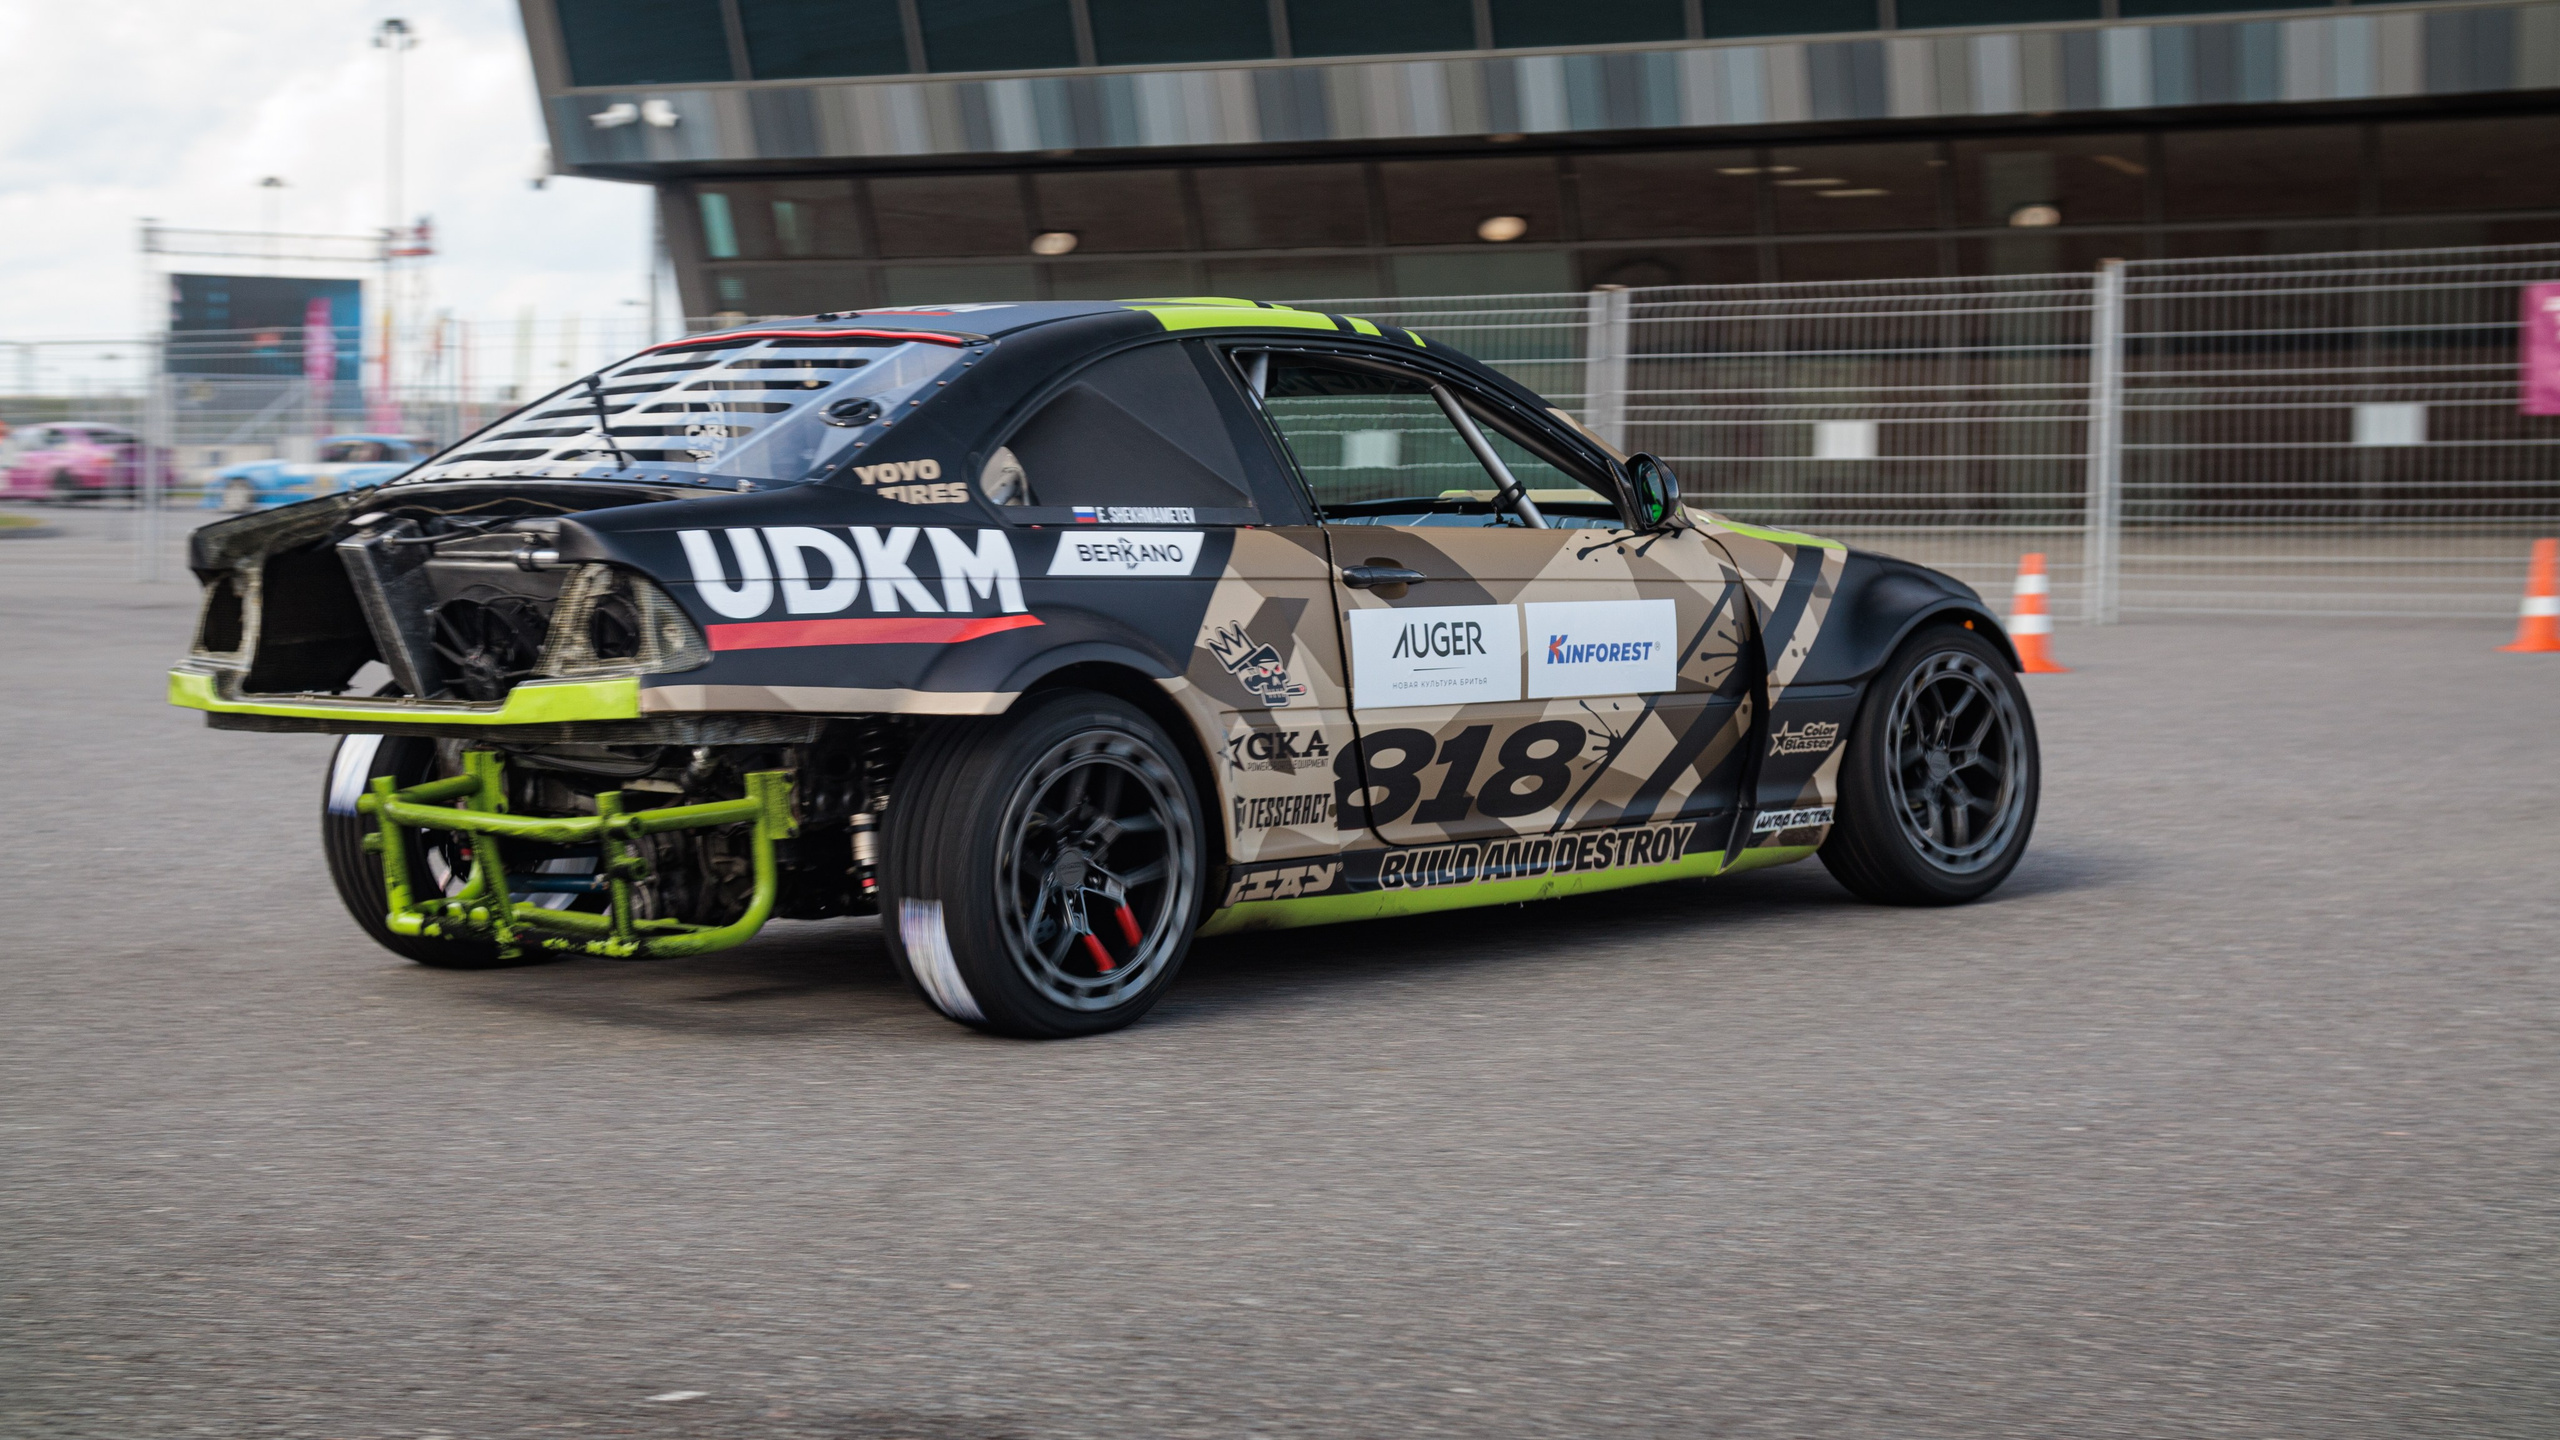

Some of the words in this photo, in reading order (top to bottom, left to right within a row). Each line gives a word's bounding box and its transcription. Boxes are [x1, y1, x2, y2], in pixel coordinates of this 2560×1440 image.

[852, 458, 941, 485] YOYO
[876, 482, 970, 504] TIRES
[1076, 542, 1183, 565] BERKANO
[677, 526, 1028, 619] UDKM
[1392, 621, 1487, 659] AUGER
[1392, 681, 1418, 690] НОВАЯ
[1421, 679, 1457, 688] КУЛЬТУРА
[1460, 677, 1488, 686] БРИТЬЯ
[1803, 723, 1838, 737] Color
[1247, 730, 1329, 760] GKA
[1784, 738, 1833, 751] Blaster
[1333, 720, 1587, 831] 818
[1249, 793, 1331, 829] TESSERACT
[1379, 844, 1478, 890] BUILD
[1479, 836, 1551, 884] AND
[1551, 823, 1696, 876] DESTROY
